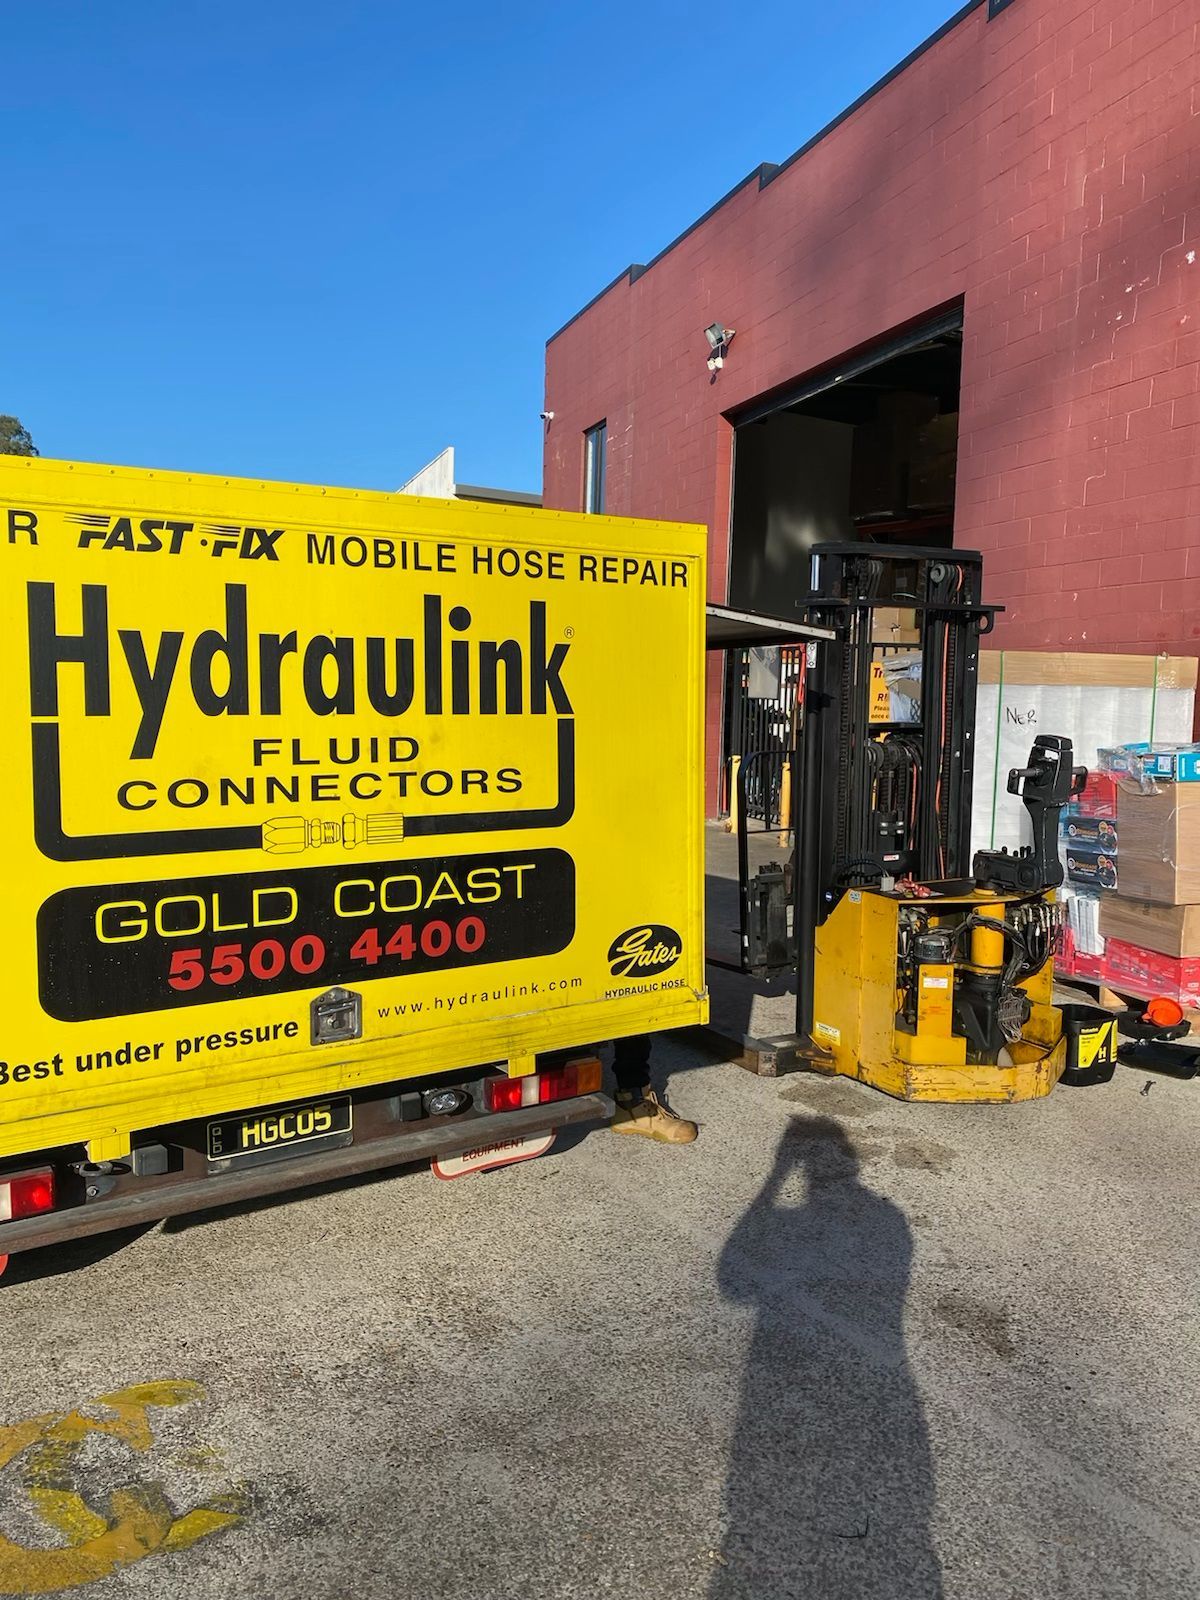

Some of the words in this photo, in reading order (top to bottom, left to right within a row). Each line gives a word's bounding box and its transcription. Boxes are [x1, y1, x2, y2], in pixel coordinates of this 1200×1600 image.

[307, 533, 457, 573] MOBILE
[472, 546, 565, 580] HOSE
[579, 555, 689, 588] REPAIR
[26, 580, 574, 760] Hydraulink
[253, 737, 419, 766] FLUID
[117, 768, 523, 811] CONNECTORS
[94, 886, 299, 944] GOLD
[333, 863, 537, 918] COAST
[167, 934, 326, 992] 5500
[349, 916, 486, 966] 4400
[606, 928, 683, 977] Gates
[377, 976, 583, 1019] www.hydraulink.com
[604, 983, 659, 999] HYDRAULIC
[661, 979, 685, 989] HOSE
[0, 1053, 64, 1086] Best
[76, 1038, 165, 1073] under
[176, 1019, 300, 1061] pressure
[462, 1136, 526, 1162] EQUIPMENT
